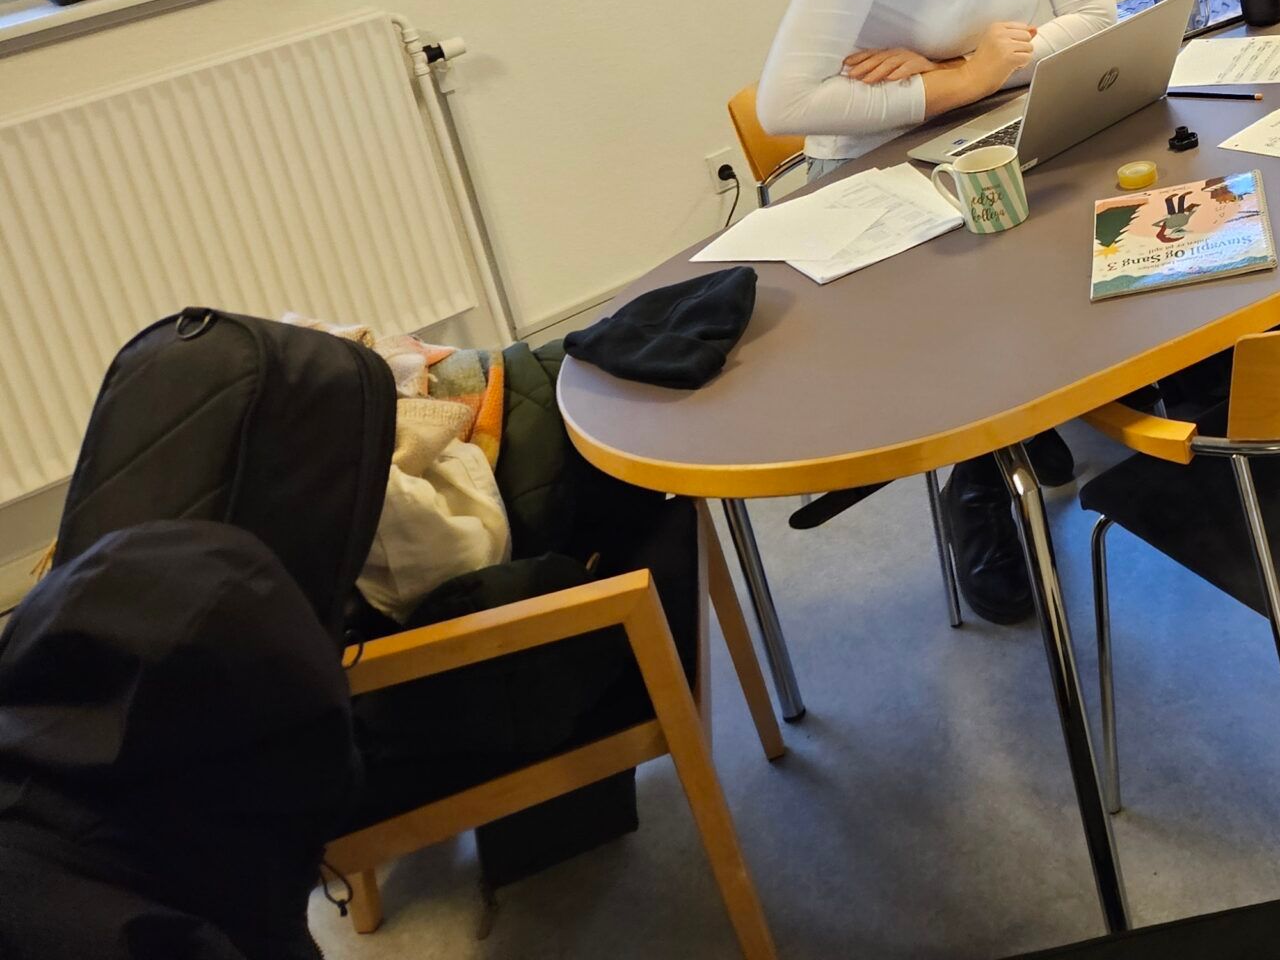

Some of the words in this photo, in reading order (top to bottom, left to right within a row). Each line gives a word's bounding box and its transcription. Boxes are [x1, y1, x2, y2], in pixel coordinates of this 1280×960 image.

[1165, 249, 1185, 259] Og
[1122, 253, 1161, 267] Sang
[1107, 262, 1118, 272] 3
